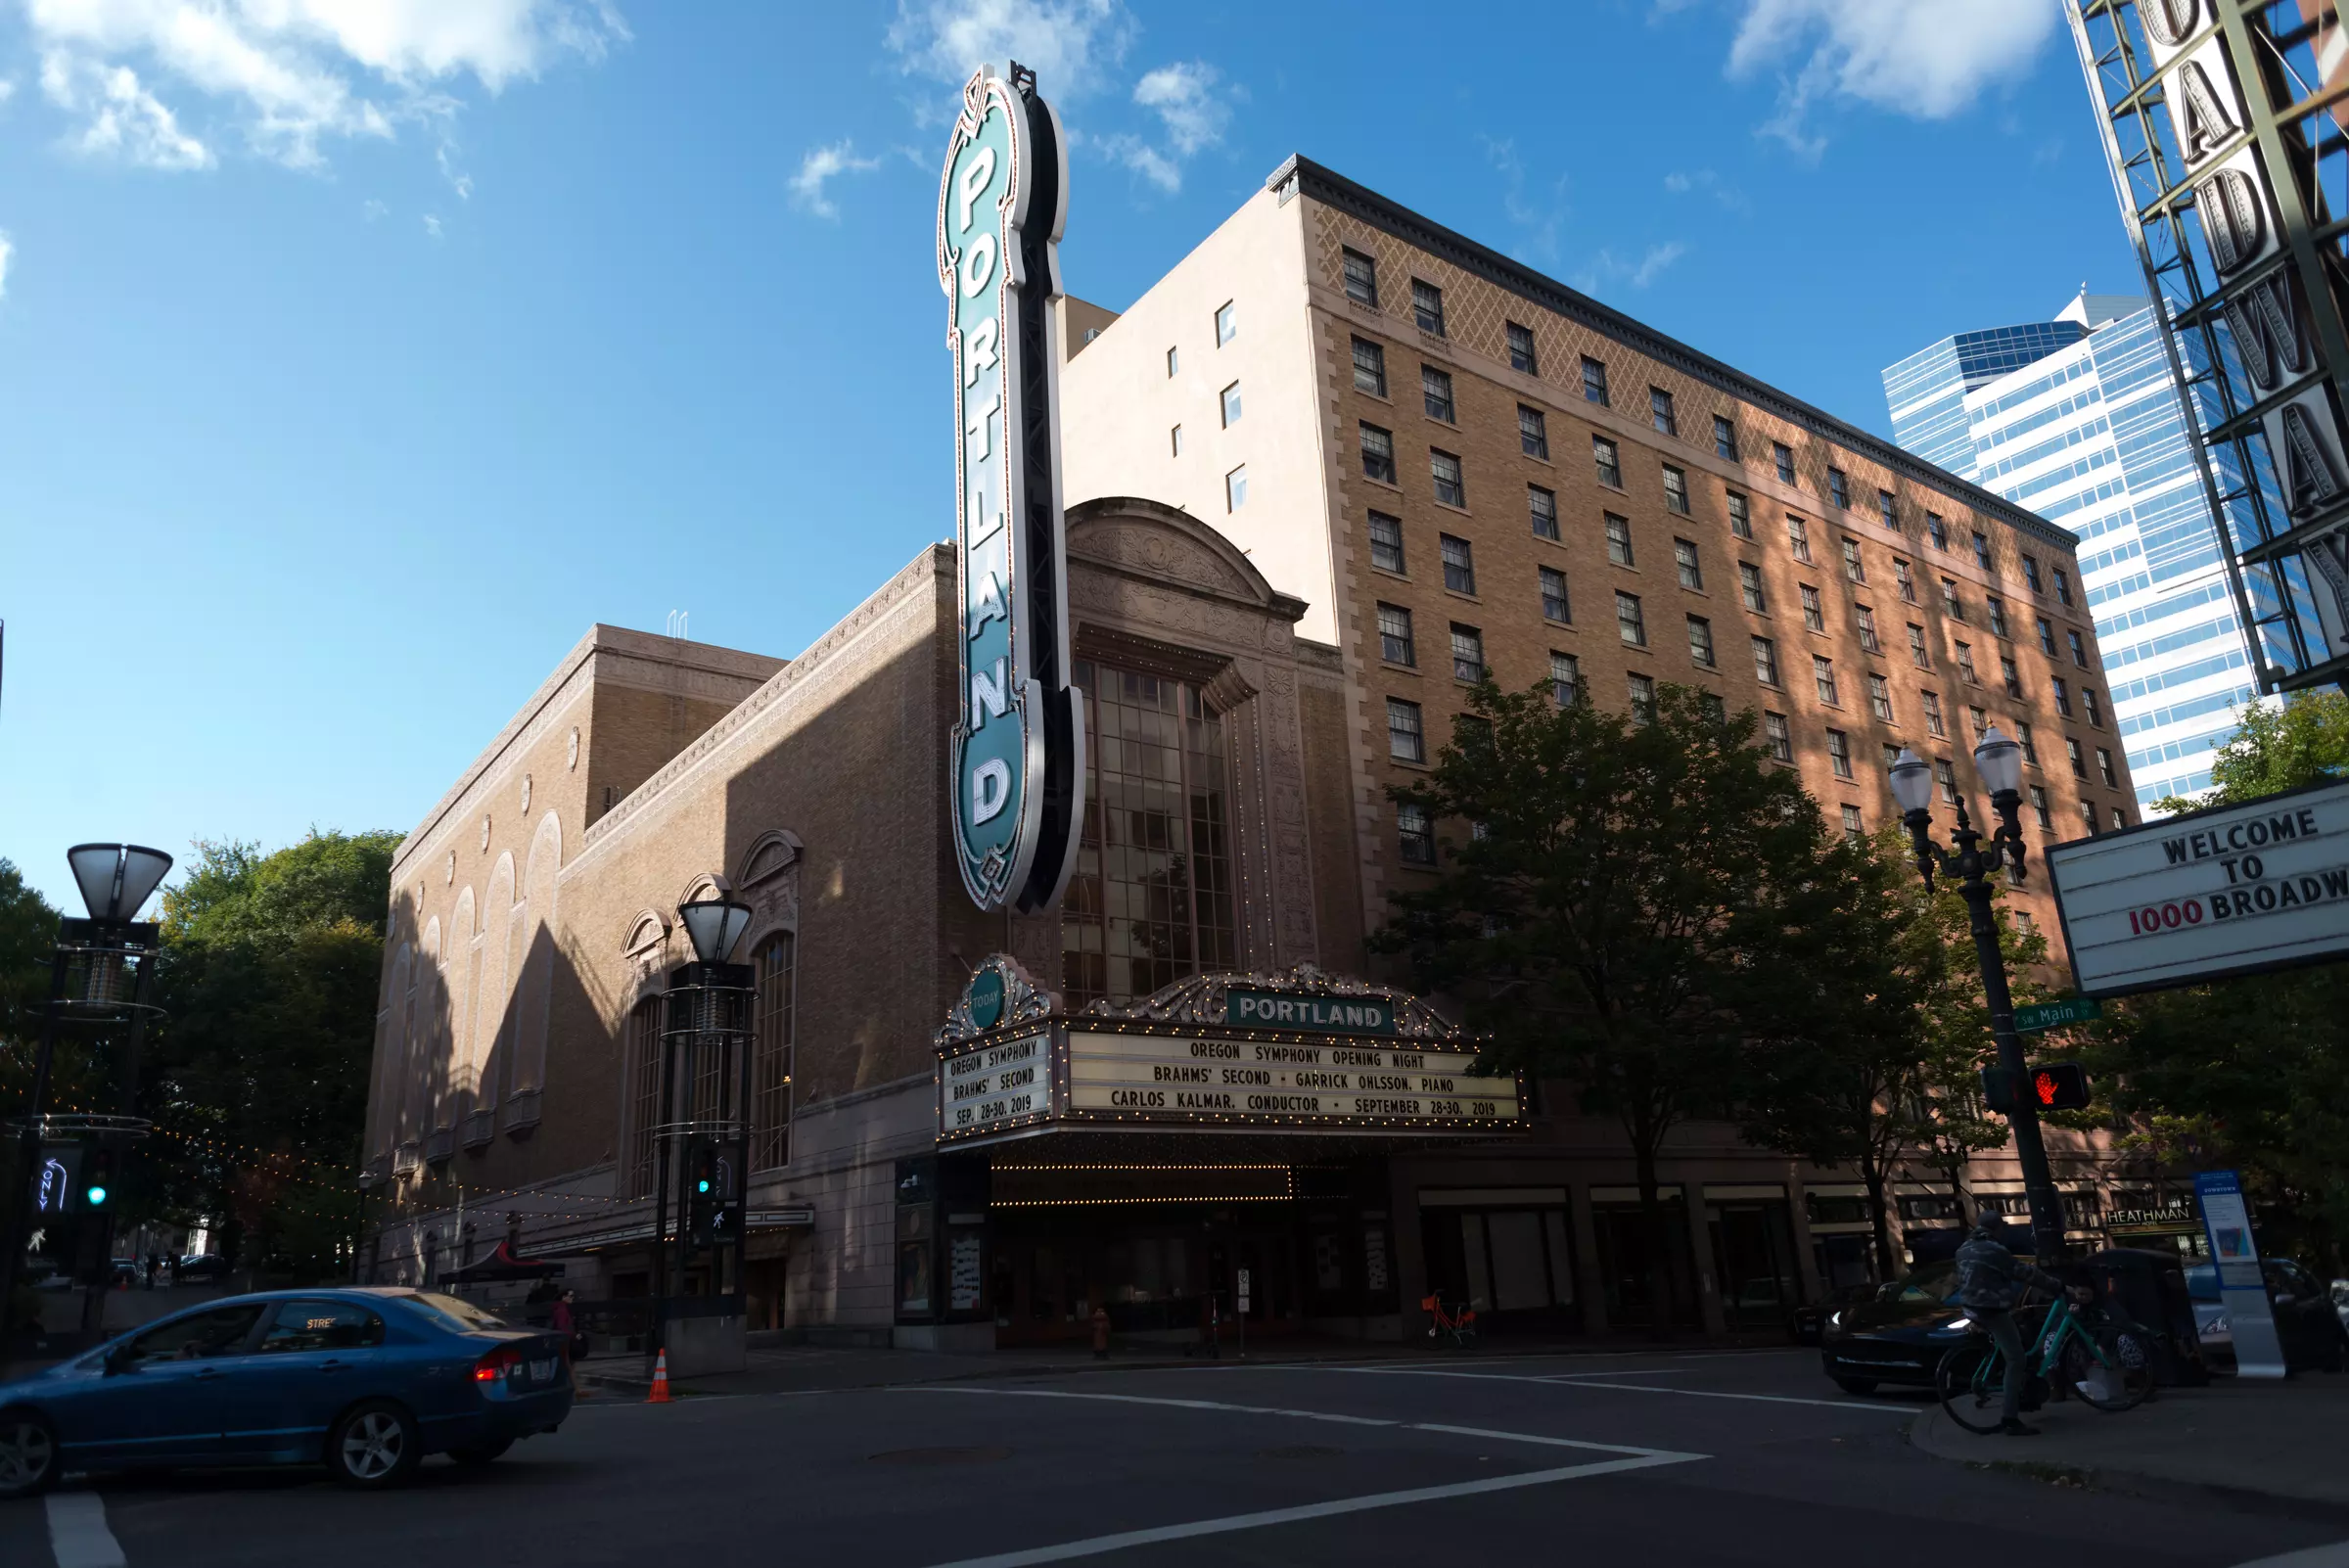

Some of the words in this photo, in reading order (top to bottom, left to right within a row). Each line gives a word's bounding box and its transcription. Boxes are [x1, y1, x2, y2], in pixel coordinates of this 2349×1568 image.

[958, 146, 1012, 827] PORTLAND
[2161, 808, 2319, 865] WELCOME
[2220, 854, 2264, 884] TO
[2129, 899, 2204, 936] 1000
[972, 990, 999, 1009] TODAY
[1239, 996, 1383, 1028] PORTLAND
[2020, 1014, 2035, 1026] SW
[2039, 1005, 2074, 1022] Main
[950, 1055, 982, 1077] OREGON
[989, 1039, 1037, 1067] SYMPHONY
[1190, 1042, 1240, 1059] OREGON
[1256, 1045, 1320, 1064] SYMPHONY
[1332, 1050, 1382, 1067] OPENING
[1393, 1053, 1425, 1069] NIGHT
[953, 1078, 990, 1101] BRAHMS'
[1000, 1067, 1035, 1090] SECOND
[1153, 1065, 1213, 1084] BRAHMS'
[1222, 1068, 1271, 1085] SECOND
[1295, 1072, 1349, 1088] GARRICK
[1421, 1078, 1454, 1092] PIANO
[1011, 1094, 1032, 1113] 2019
[1111, 1089, 1165, 1107] CARLOS
[1247, 1094, 1319, 1112] CONDUCTOR
[1355, 1098, 1420, 1115] SEPTEMBER
[1472, 1101, 1497, 1117] 2019
[38, 1170, 54, 1213] ONLY
[2106, 1207, 2190, 1223] HEATHMAN
